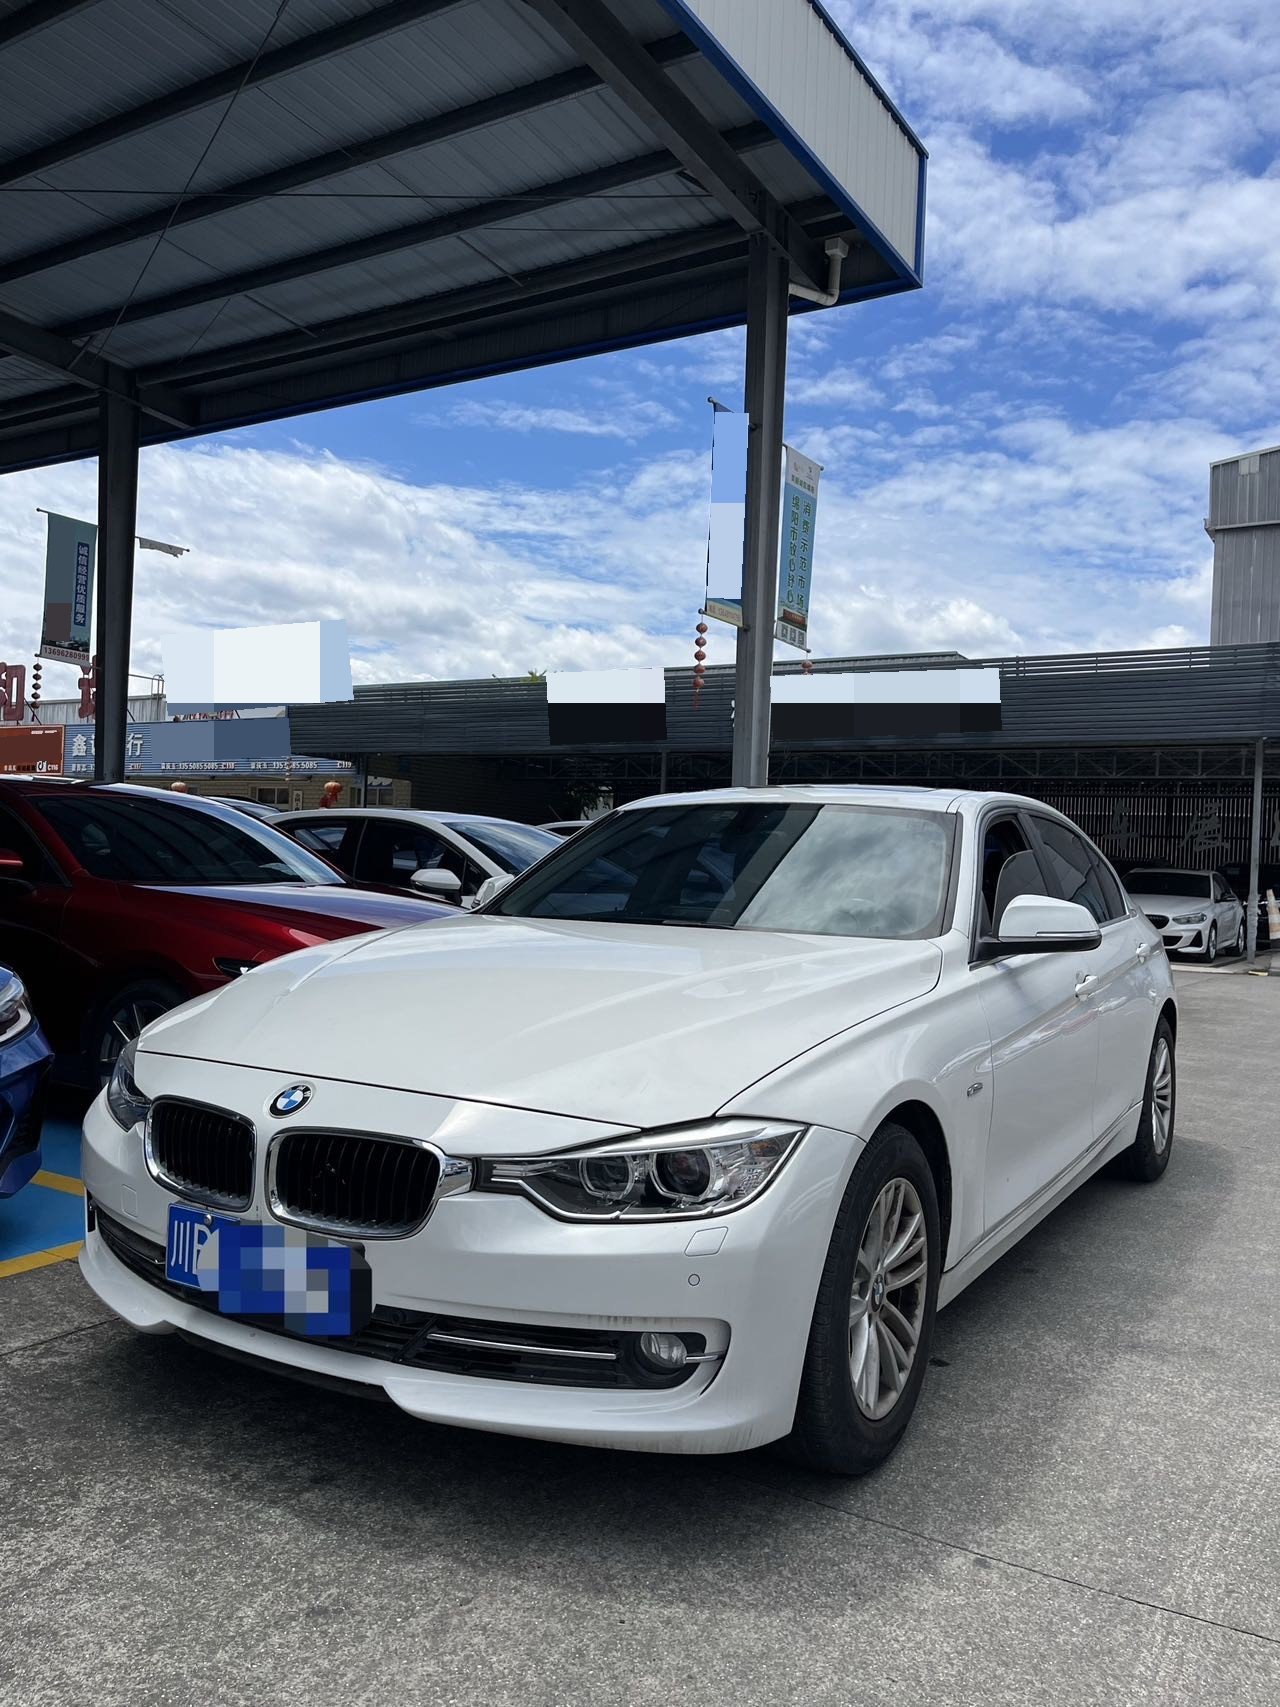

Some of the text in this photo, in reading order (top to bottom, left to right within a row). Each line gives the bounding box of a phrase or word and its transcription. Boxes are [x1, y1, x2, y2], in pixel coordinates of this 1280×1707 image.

[75, 545, 89, 624] 诚信经营优质服务
